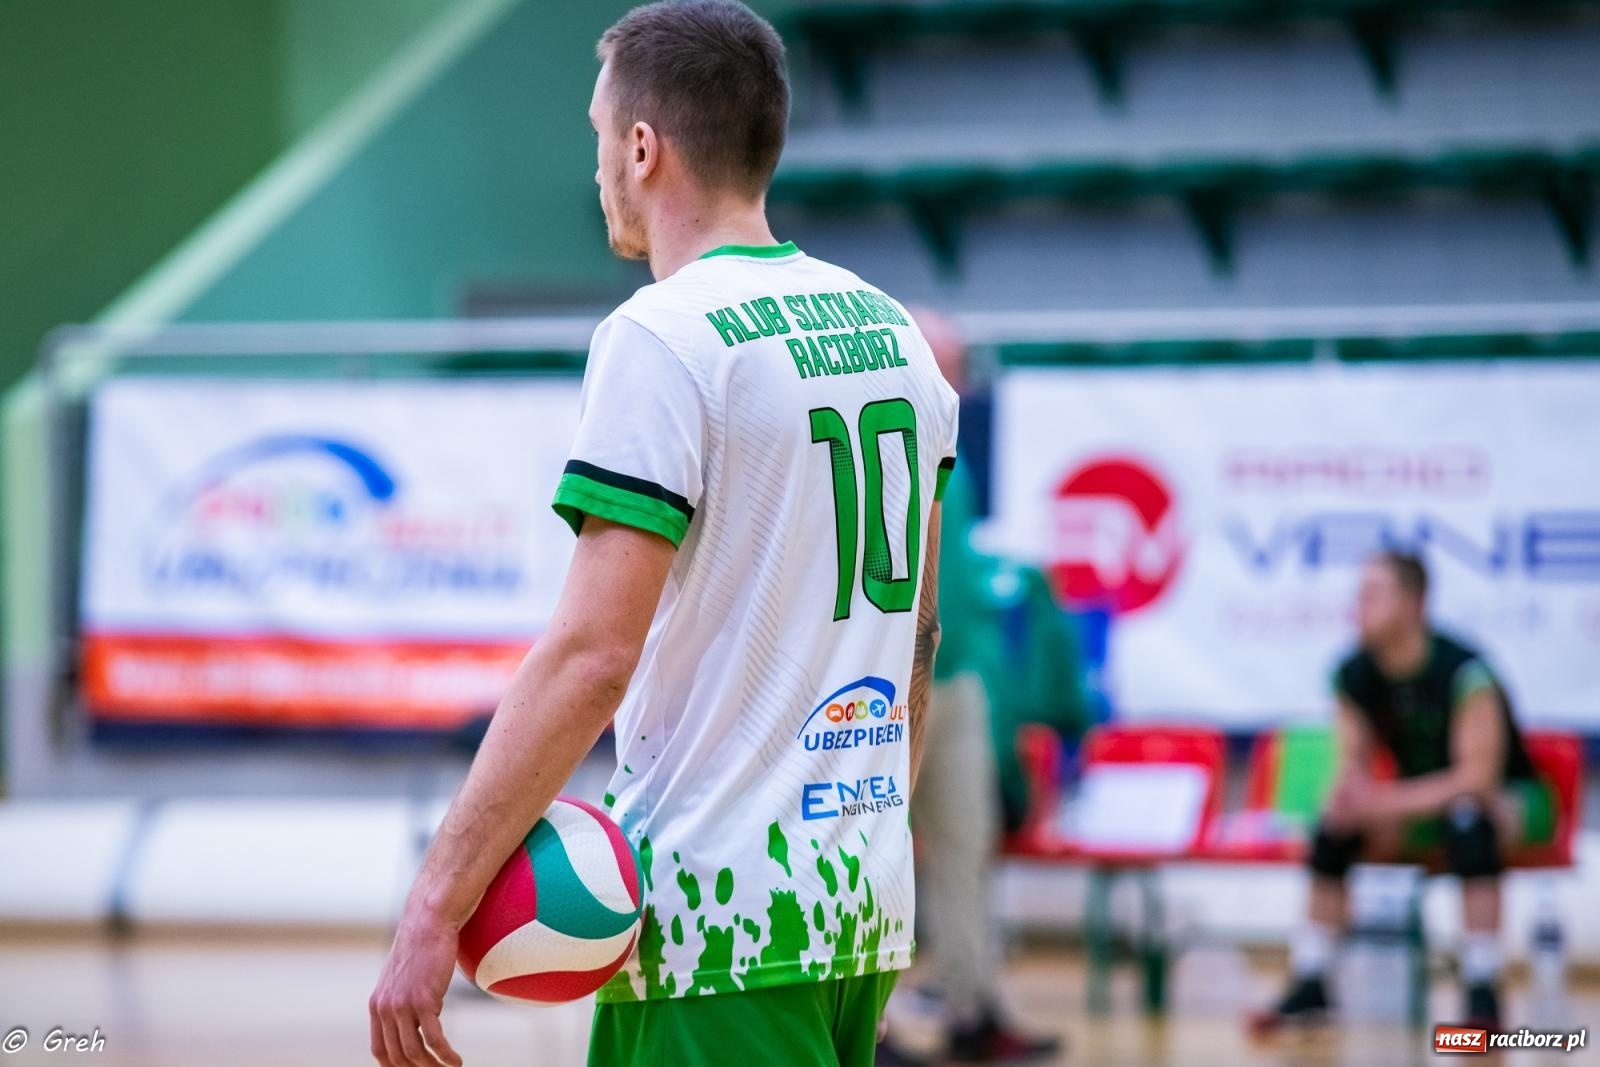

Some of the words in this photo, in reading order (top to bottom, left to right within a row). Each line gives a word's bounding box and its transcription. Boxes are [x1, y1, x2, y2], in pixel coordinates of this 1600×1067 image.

[705, 296, 791, 347] KLUB
[785, 327, 908, 379] RACIBÓRZ
[808, 398, 920, 622] 10
